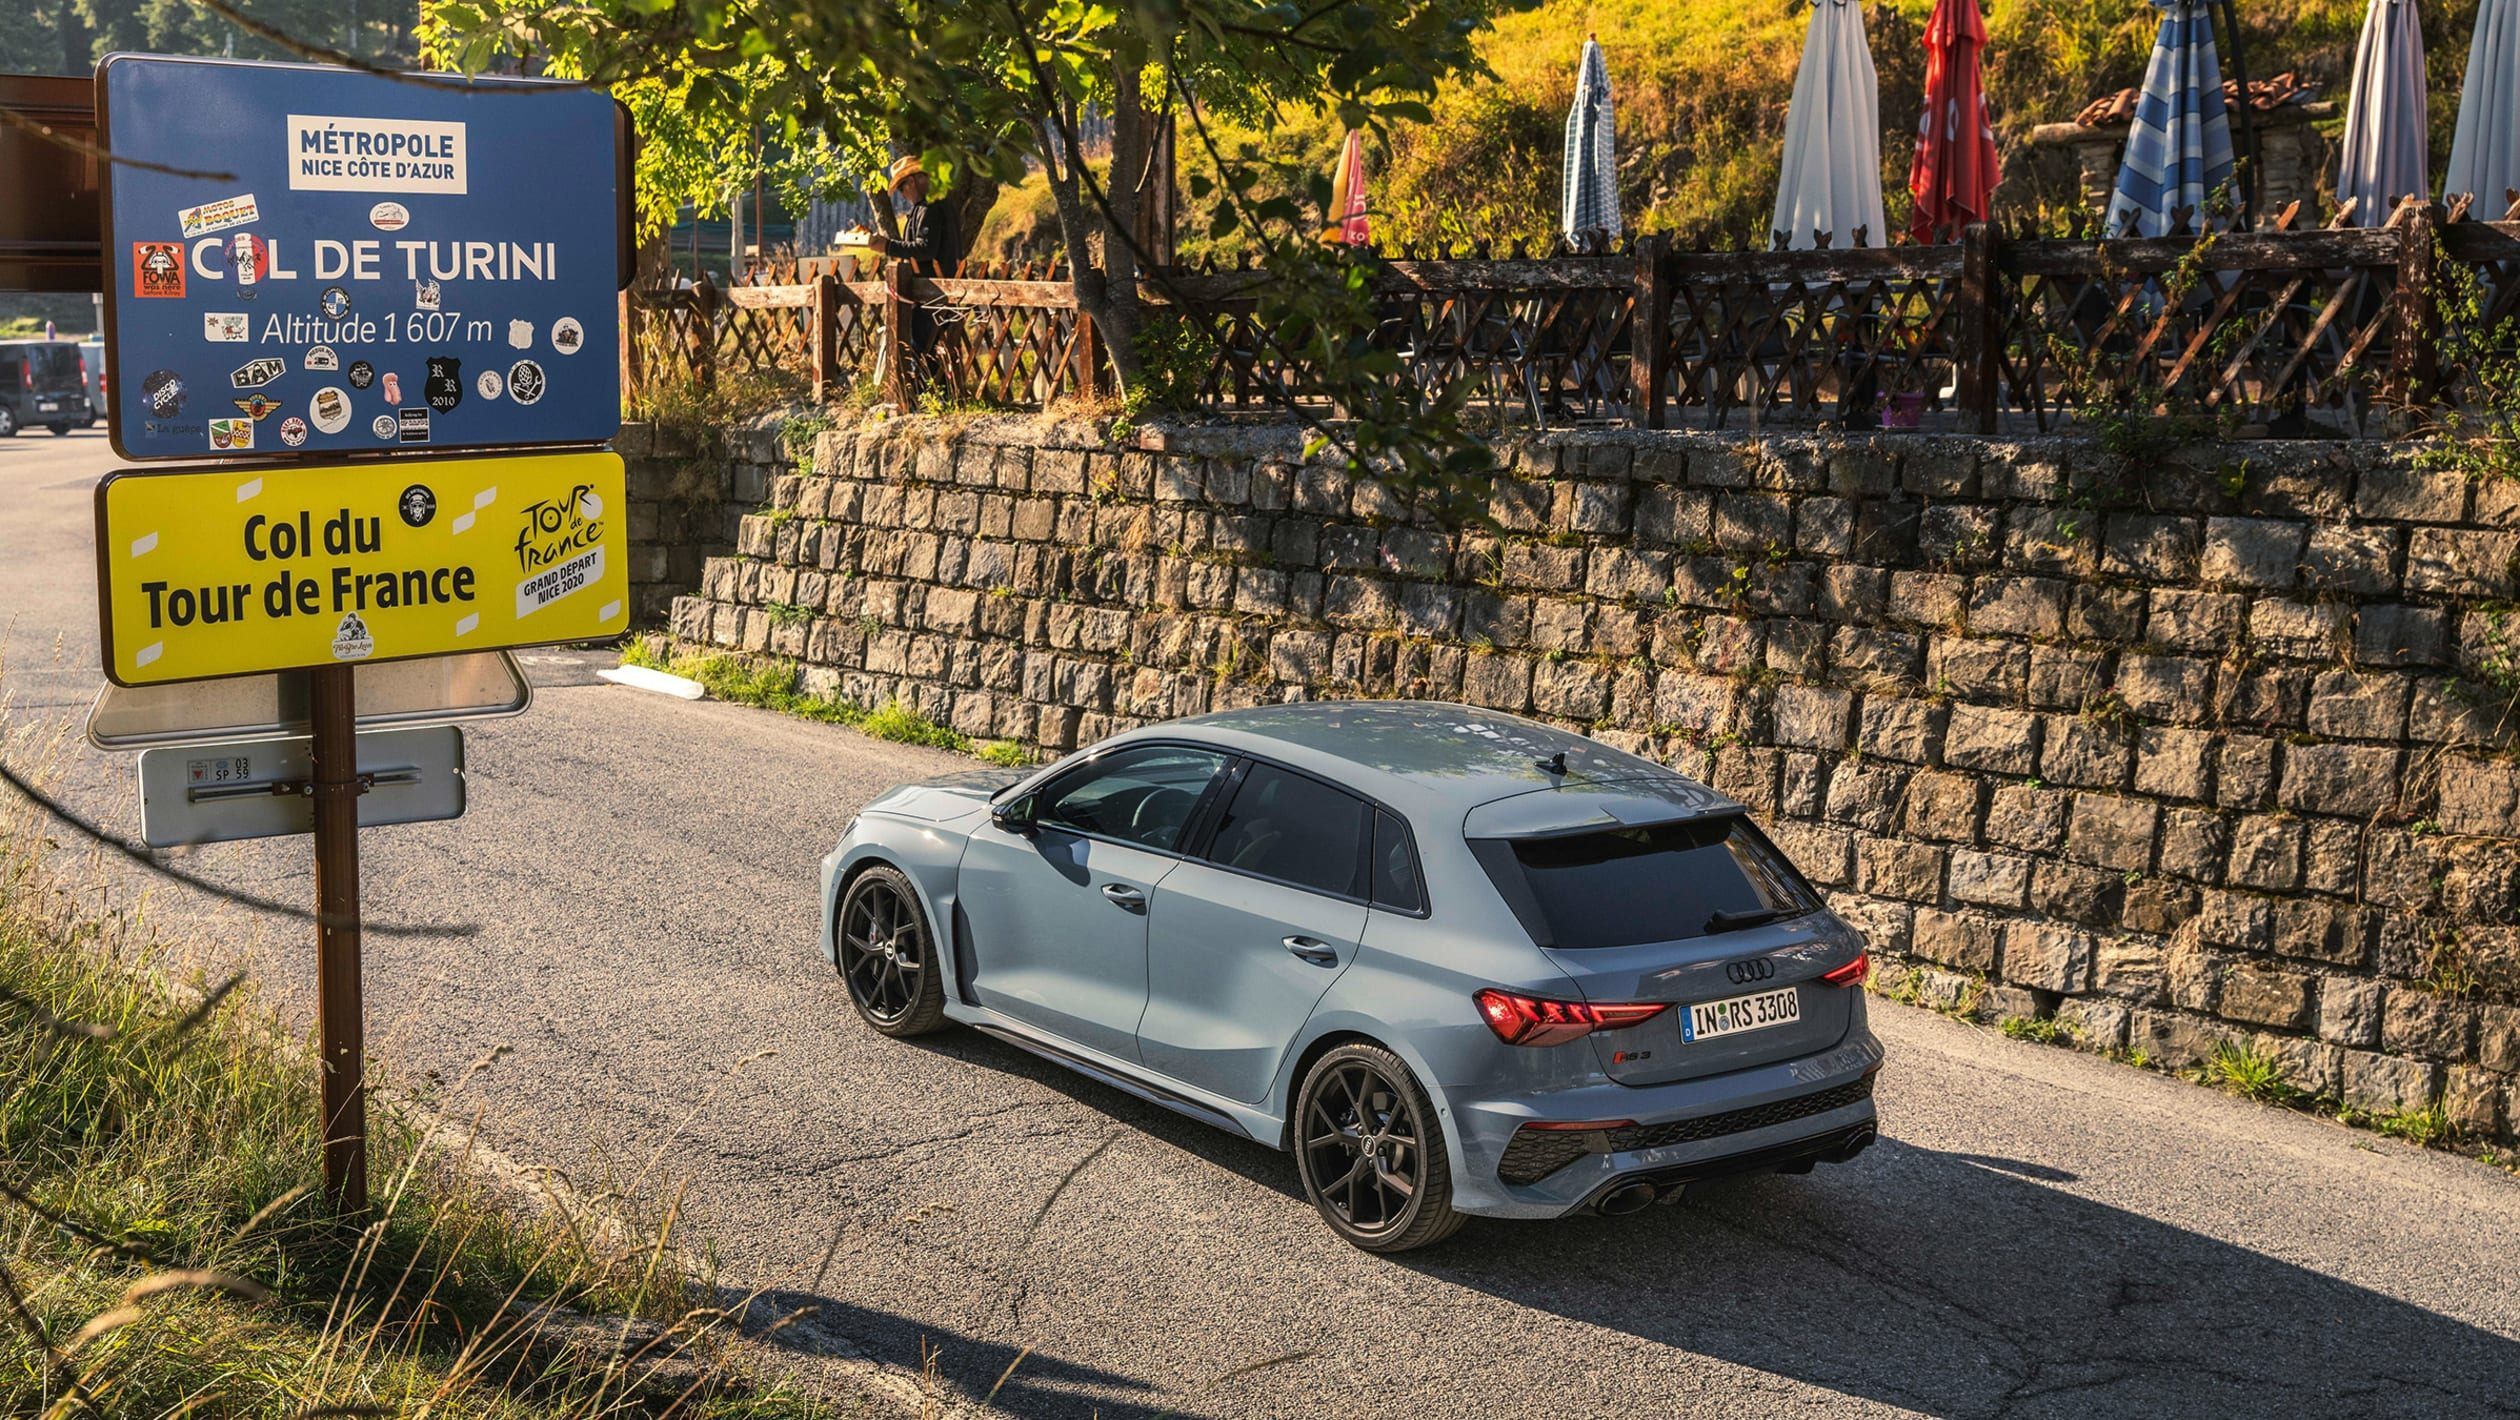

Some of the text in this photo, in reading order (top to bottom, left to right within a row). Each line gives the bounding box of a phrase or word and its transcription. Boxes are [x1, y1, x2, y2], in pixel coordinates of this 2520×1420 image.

[301, 123, 454, 158] MÉTROPOLE
[302, 157, 455, 180] NICE CÔTE D'AZUR
[191, 237, 298, 281] CL
[314, 239, 382, 280] DE
[395, 241, 557, 281] TURINI
[143, 271, 181, 285] FOWA
[261, 312, 377, 345] Altitude
[406, 311, 463, 343] 607
[467, 320, 493, 342] m
[153, 379, 176, 401] DISCO
[432, 396, 456, 406] 2010
[243, 508, 381, 561] Col du
[523, 551, 597, 597] GRAND DÉPART
[537, 573, 585, 605] NICE 2020
[142, 565, 475, 629] Tour de France
[216, 769, 229, 781] SP
[235, 757, 249, 769] 03
[1695, 991, 1798, 1036] IN RS 3308
